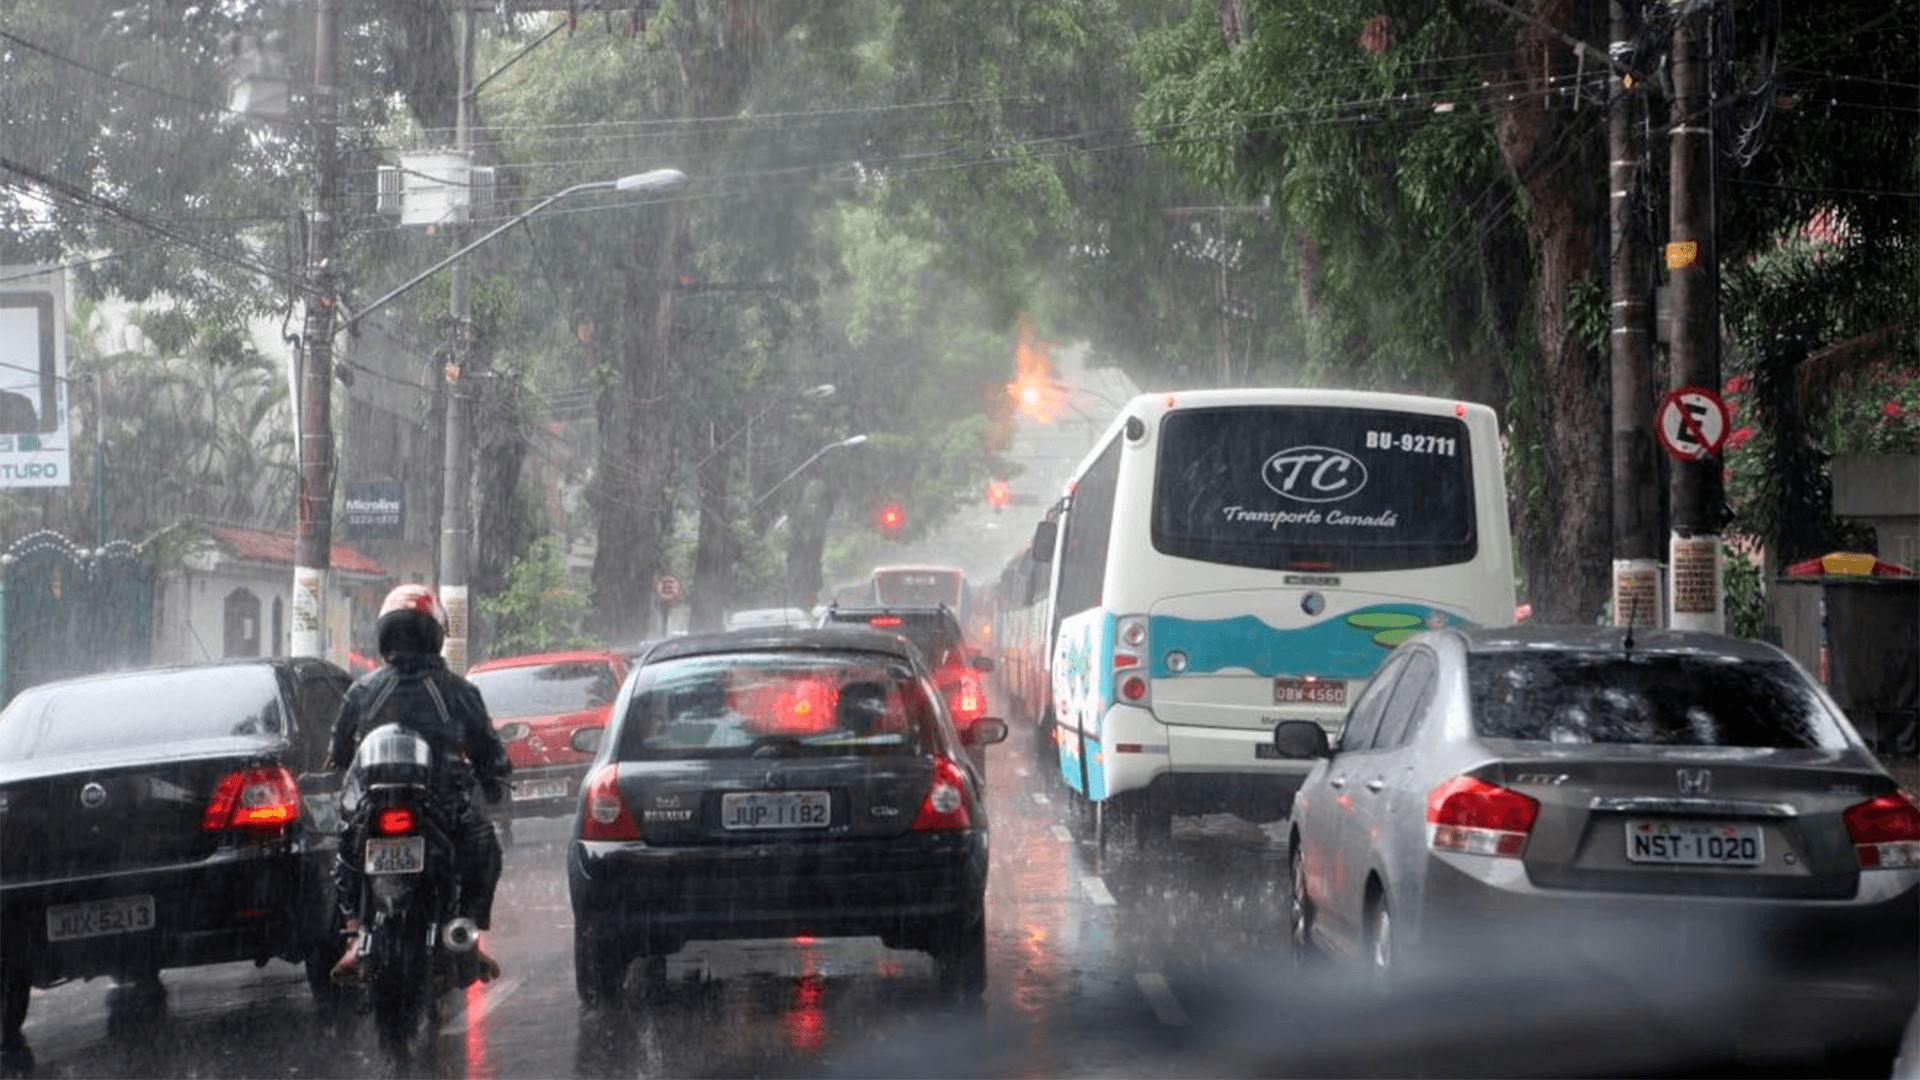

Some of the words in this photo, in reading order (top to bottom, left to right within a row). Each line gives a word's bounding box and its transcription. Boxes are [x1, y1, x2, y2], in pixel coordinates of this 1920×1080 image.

[1676, 403, 1707, 444] E
[1366, 431, 1455, 456] BU-92711
[0, 463, 58, 479] TURO
[1272, 455, 1350, 491] TC
[1223, 506, 1321, 531] Transporte
[1326, 509, 1398, 527] Canadá
[1635, 834, 1756, 859] NST-1020
